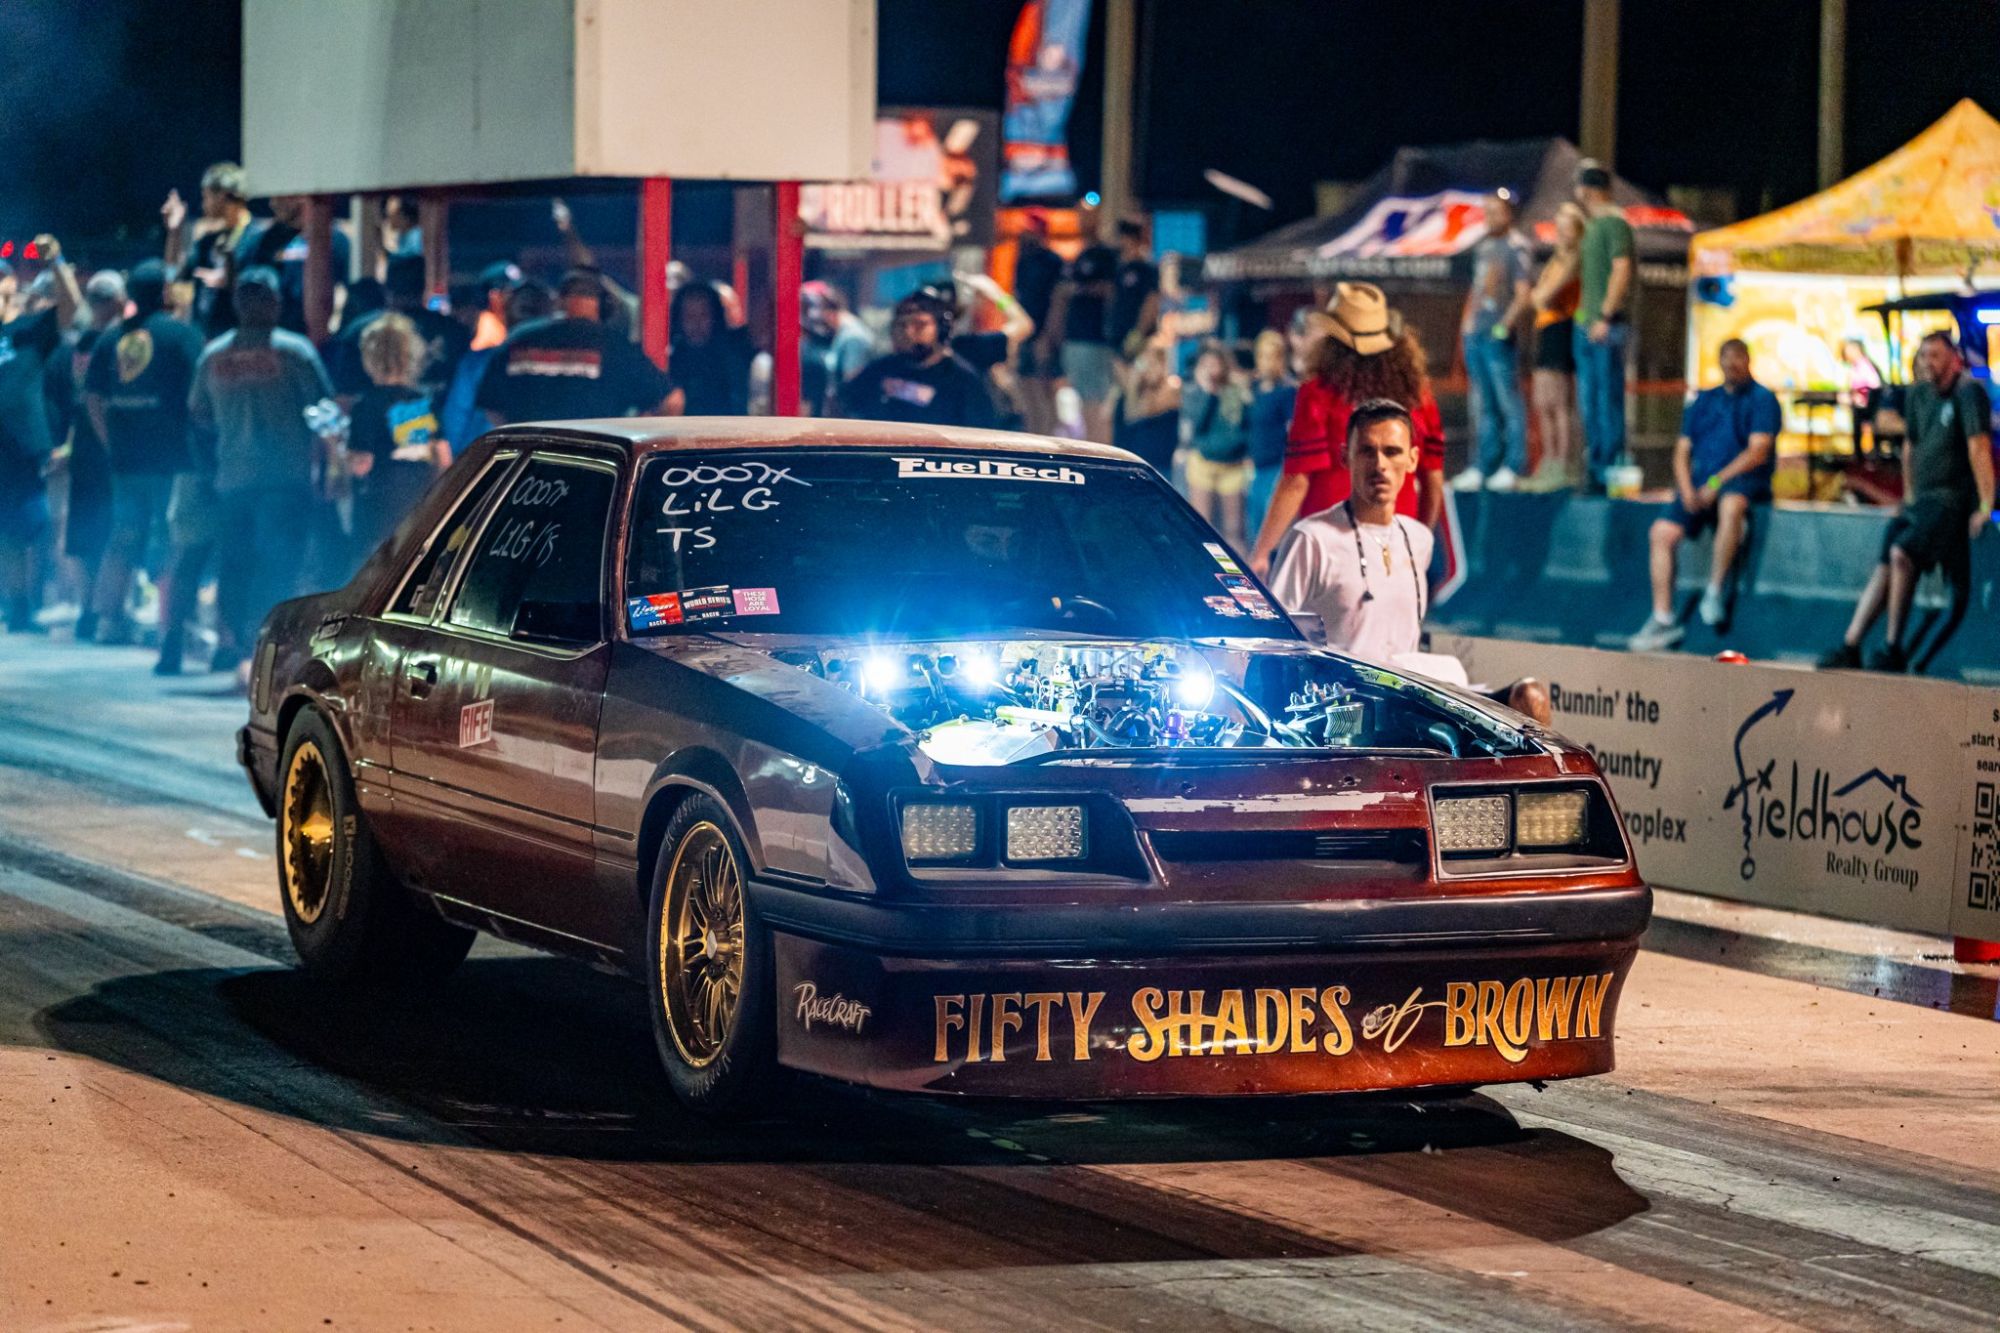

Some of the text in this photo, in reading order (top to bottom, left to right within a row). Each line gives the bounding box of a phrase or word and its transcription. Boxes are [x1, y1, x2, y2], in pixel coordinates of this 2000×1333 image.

[891, 457, 1085, 484] FuelTech
[741, 487, 780, 511] G
[656, 526, 716, 552] TS
[1549, 682, 1660, 724] Runnin' the
[1971, 733, 1995, 748] start
[1826, 851, 1919, 892] Realty Group
[934, 972, 1613, 1062] FIFTY SHADES of BROWN
